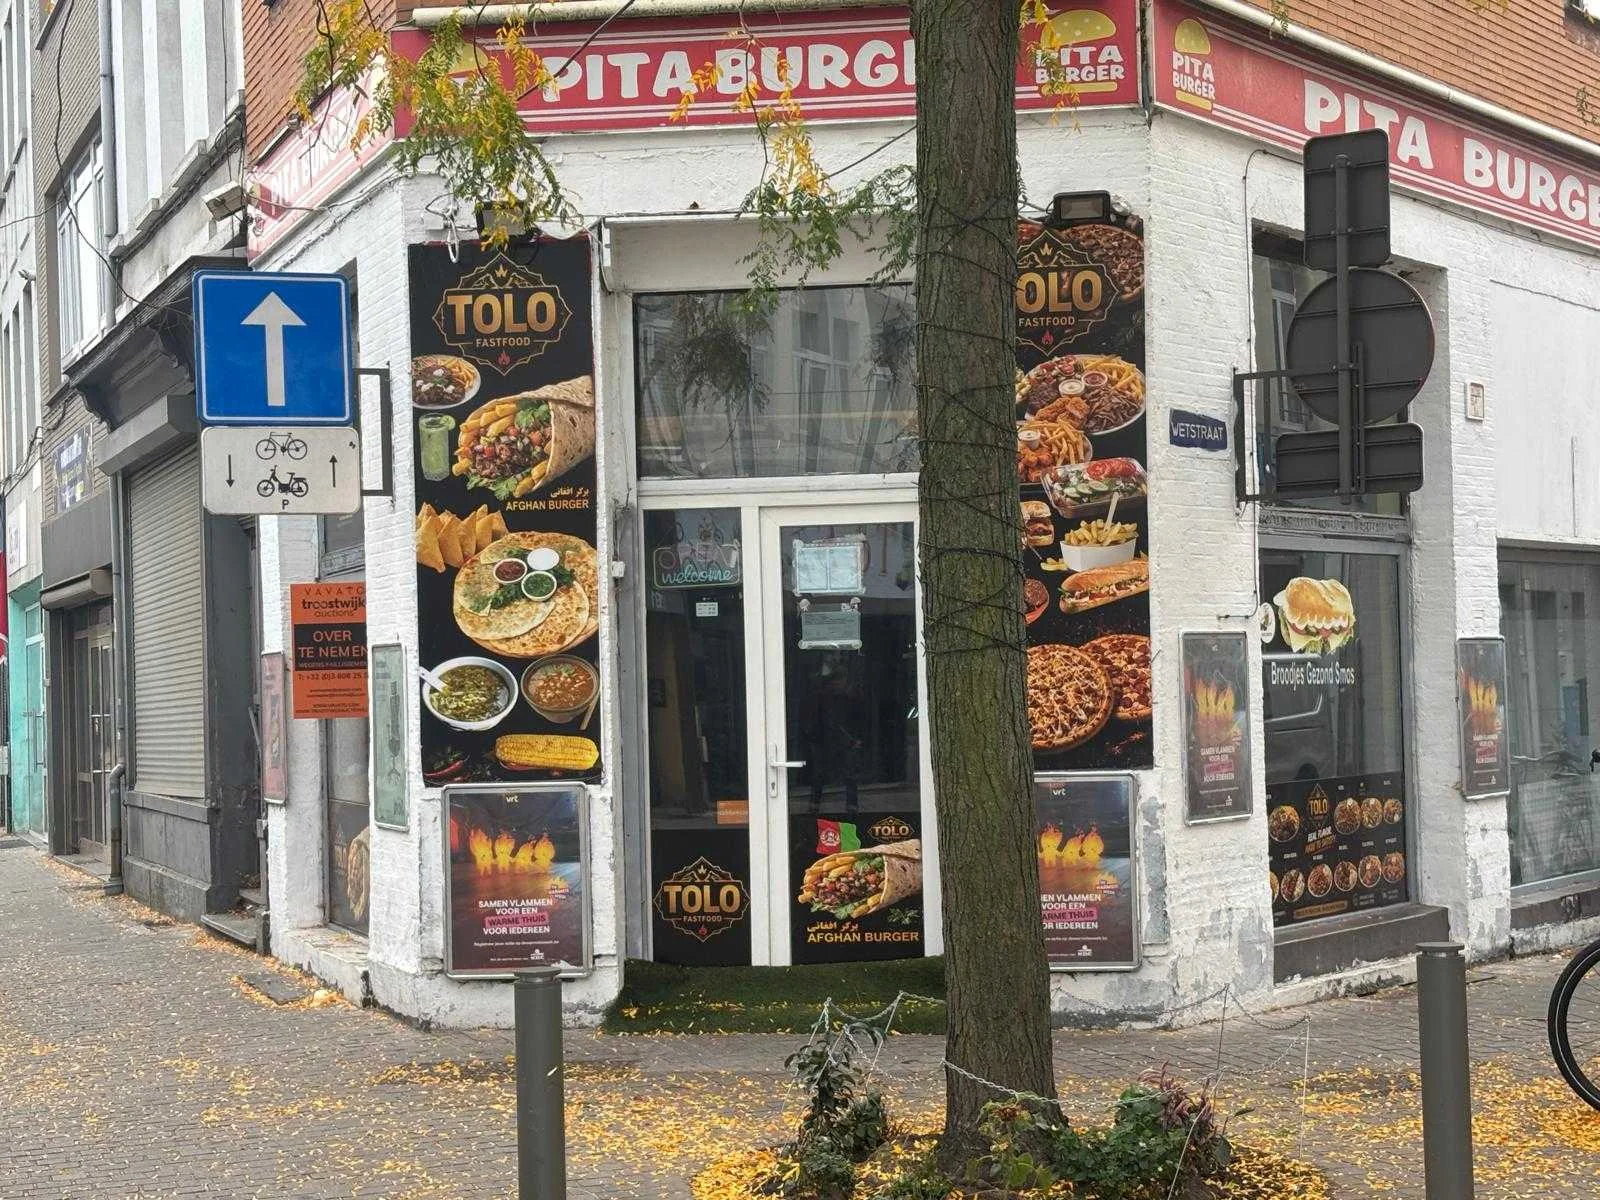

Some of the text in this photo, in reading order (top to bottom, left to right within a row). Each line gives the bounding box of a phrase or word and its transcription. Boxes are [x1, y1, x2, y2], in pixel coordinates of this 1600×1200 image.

[542, 38, 916, 102] PITA BURG
[1172, 51, 1215, 82] PITA
[1036, 64, 1125, 84] BRGER
[1172, 70, 1216, 100] BURGER
[1303, 79, 1434, 169] PITA
[1016, 271, 1102, 314] OLO
[446, 291, 556, 335] TOLO
[1018, 316, 1075, 327] FASTFOOD
[476, 336, 531, 348] FASTFOOD
[1171, 421, 1224, 441] WETSTRAAT
[282, 499, 290, 510] P
[506, 499, 589, 512] AFGHAN BURGER
[302, 597, 366, 611] troostwijk
[313, 630, 353, 642] OVER
[298, 646, 368, 658] TE NEMEN
[1271, 661, 1305, 691] Broodjes
[1306, 661, 1334, 685] Gezond
[872, 825, 909, 837] TOLO
[478, 898, 553, 908] SAMEN VLAMMEN
[663, 885, 741, 914] TOLO
[1056, 893, 1101, 902] VLAMMEN
[495, 907, 520, 915] VOOR
[1041, 902, 1067, 910] VOOR
[683, 915, 722, 923] FASTFOOD
[483, 926, 550, 935] VOOR IEDEREEN
[807, 931, 919, 943] AFGHAN BURGER
